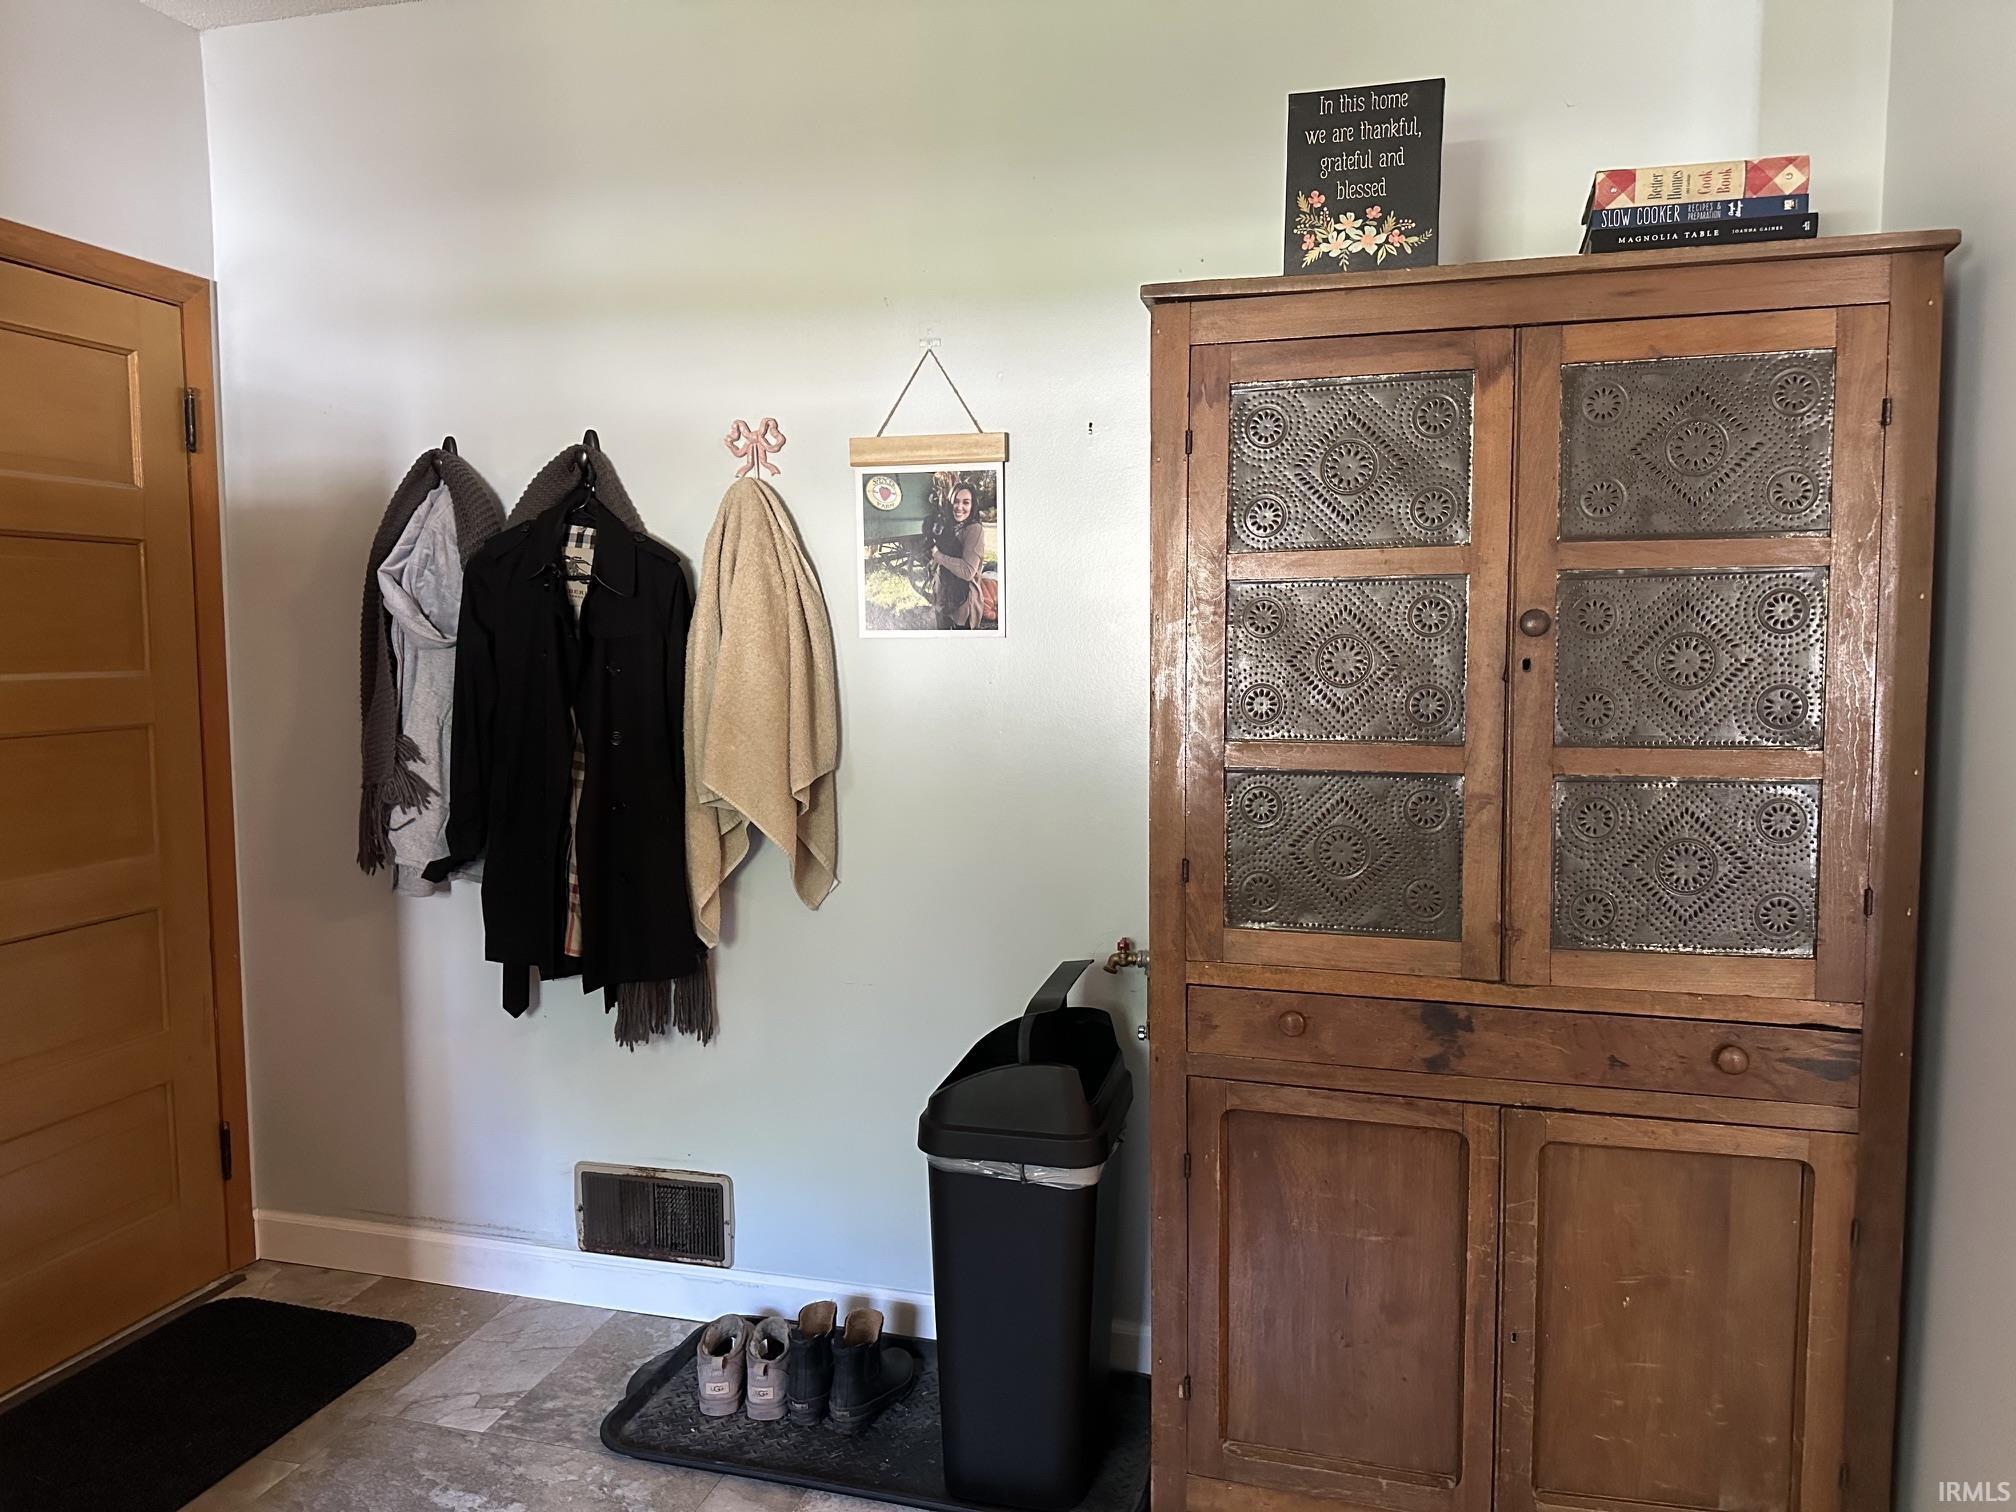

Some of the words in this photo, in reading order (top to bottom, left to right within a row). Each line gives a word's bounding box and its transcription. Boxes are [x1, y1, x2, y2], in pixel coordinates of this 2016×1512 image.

[1320, 96, 1334, 115] In
[1339, 93, 1365, 113] this
[1371, 91, 1408, 110] home
[1304, 128, 1326, 145] we
[1332, 127, 1354, 143] are
[1360, 116, 1422, 140] thankful,
[1320, 150, 1373, 179] grateful
[1379, 147, 1405, 167] and
[1336, 177, 1387, 200] blessed
[1647, 173, 1664, 200] Better
[1667, 170, 1683, 200] Homes
[1697, 170, 1713, 195] Cook
[1716, 168, 1732, 194] Book
[1601, 208, 1632, 228] SLOW
[1637, 204, 1680, 225] COOKER
[1687, 202, 1714, 212] RECIPES
[1687, 210, 1721, 221] PREPARATION
[1618, 233, 1678, 244] MAGNOLIA
[1684, 229, 1720, 239] TABLE
[1732, 227, 1757, 235] JOANNA
